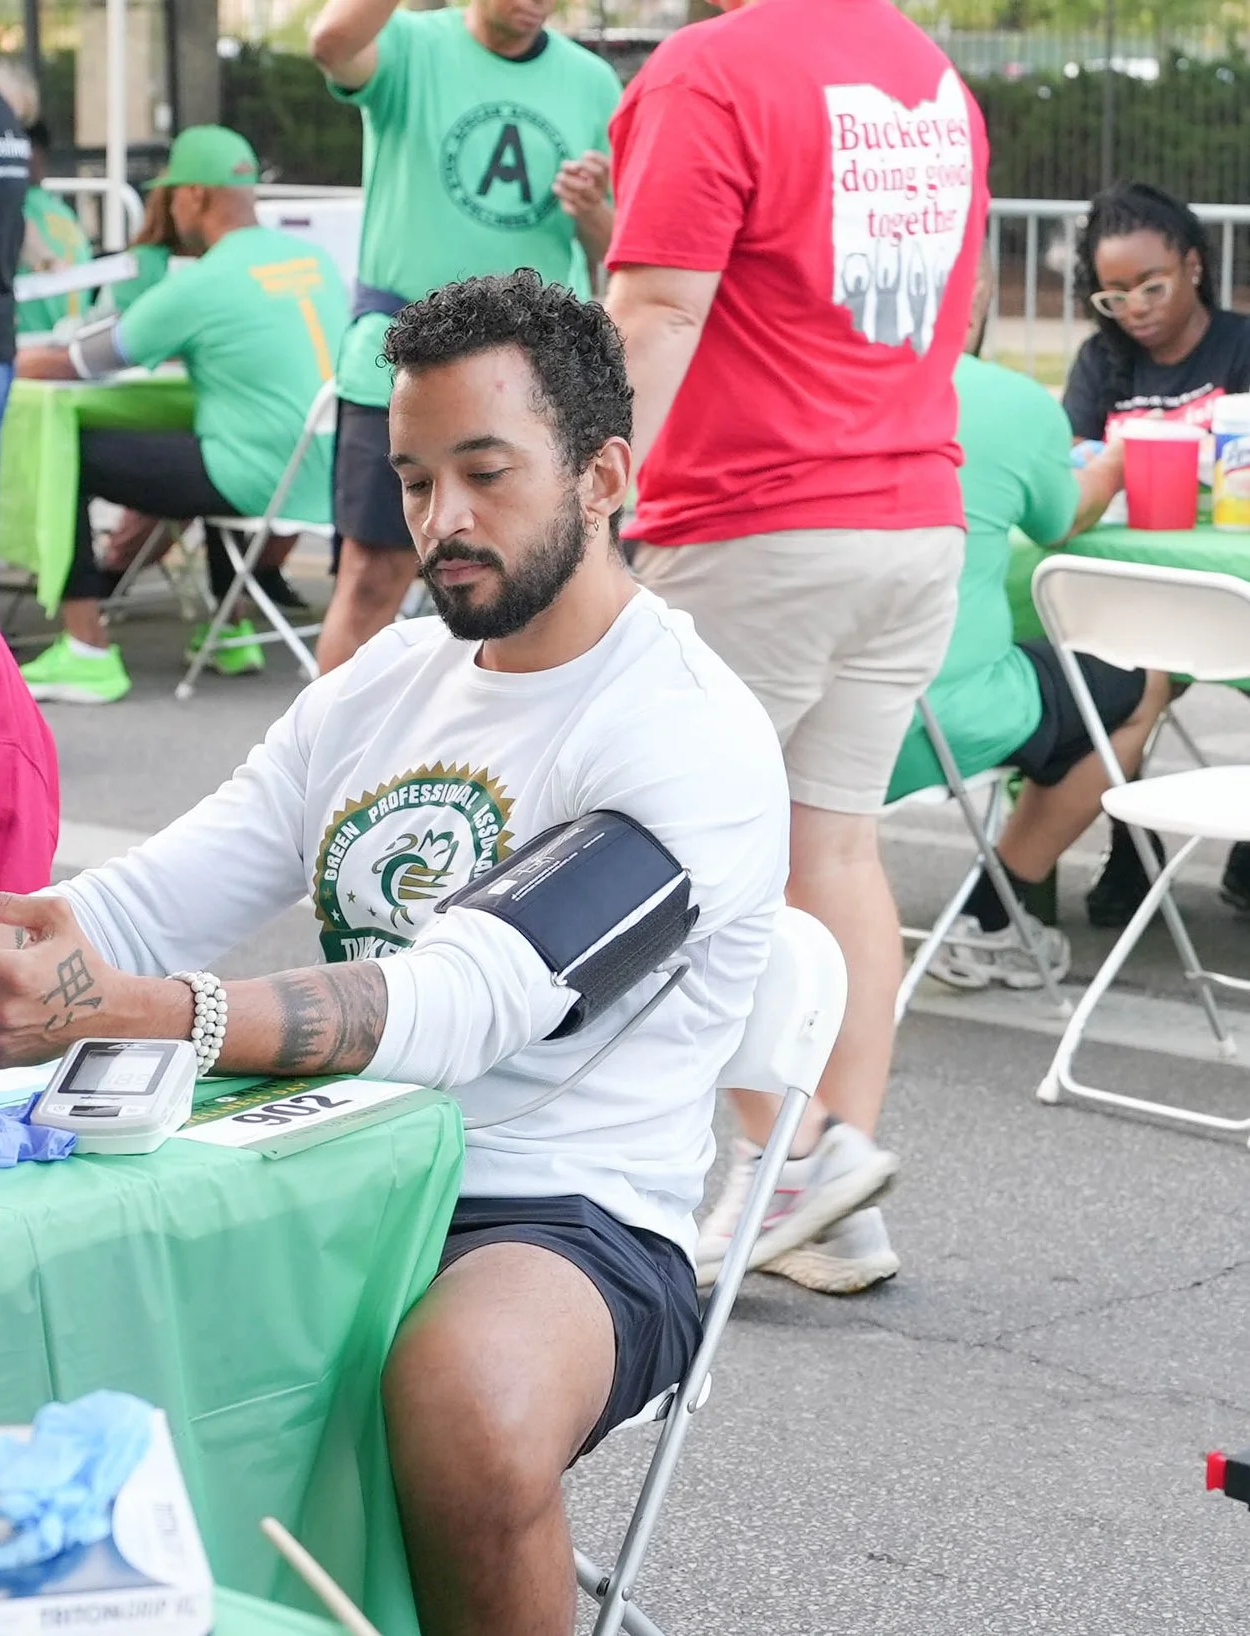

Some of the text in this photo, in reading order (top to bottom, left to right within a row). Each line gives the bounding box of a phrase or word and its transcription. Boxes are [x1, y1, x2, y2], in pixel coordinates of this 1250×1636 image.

[835, 111, 969, 150] Buckeyes
[476, 123, 532, 204] A
[841, 158, 918, 200] doing
[232, 1095, 354, 1126] 902
